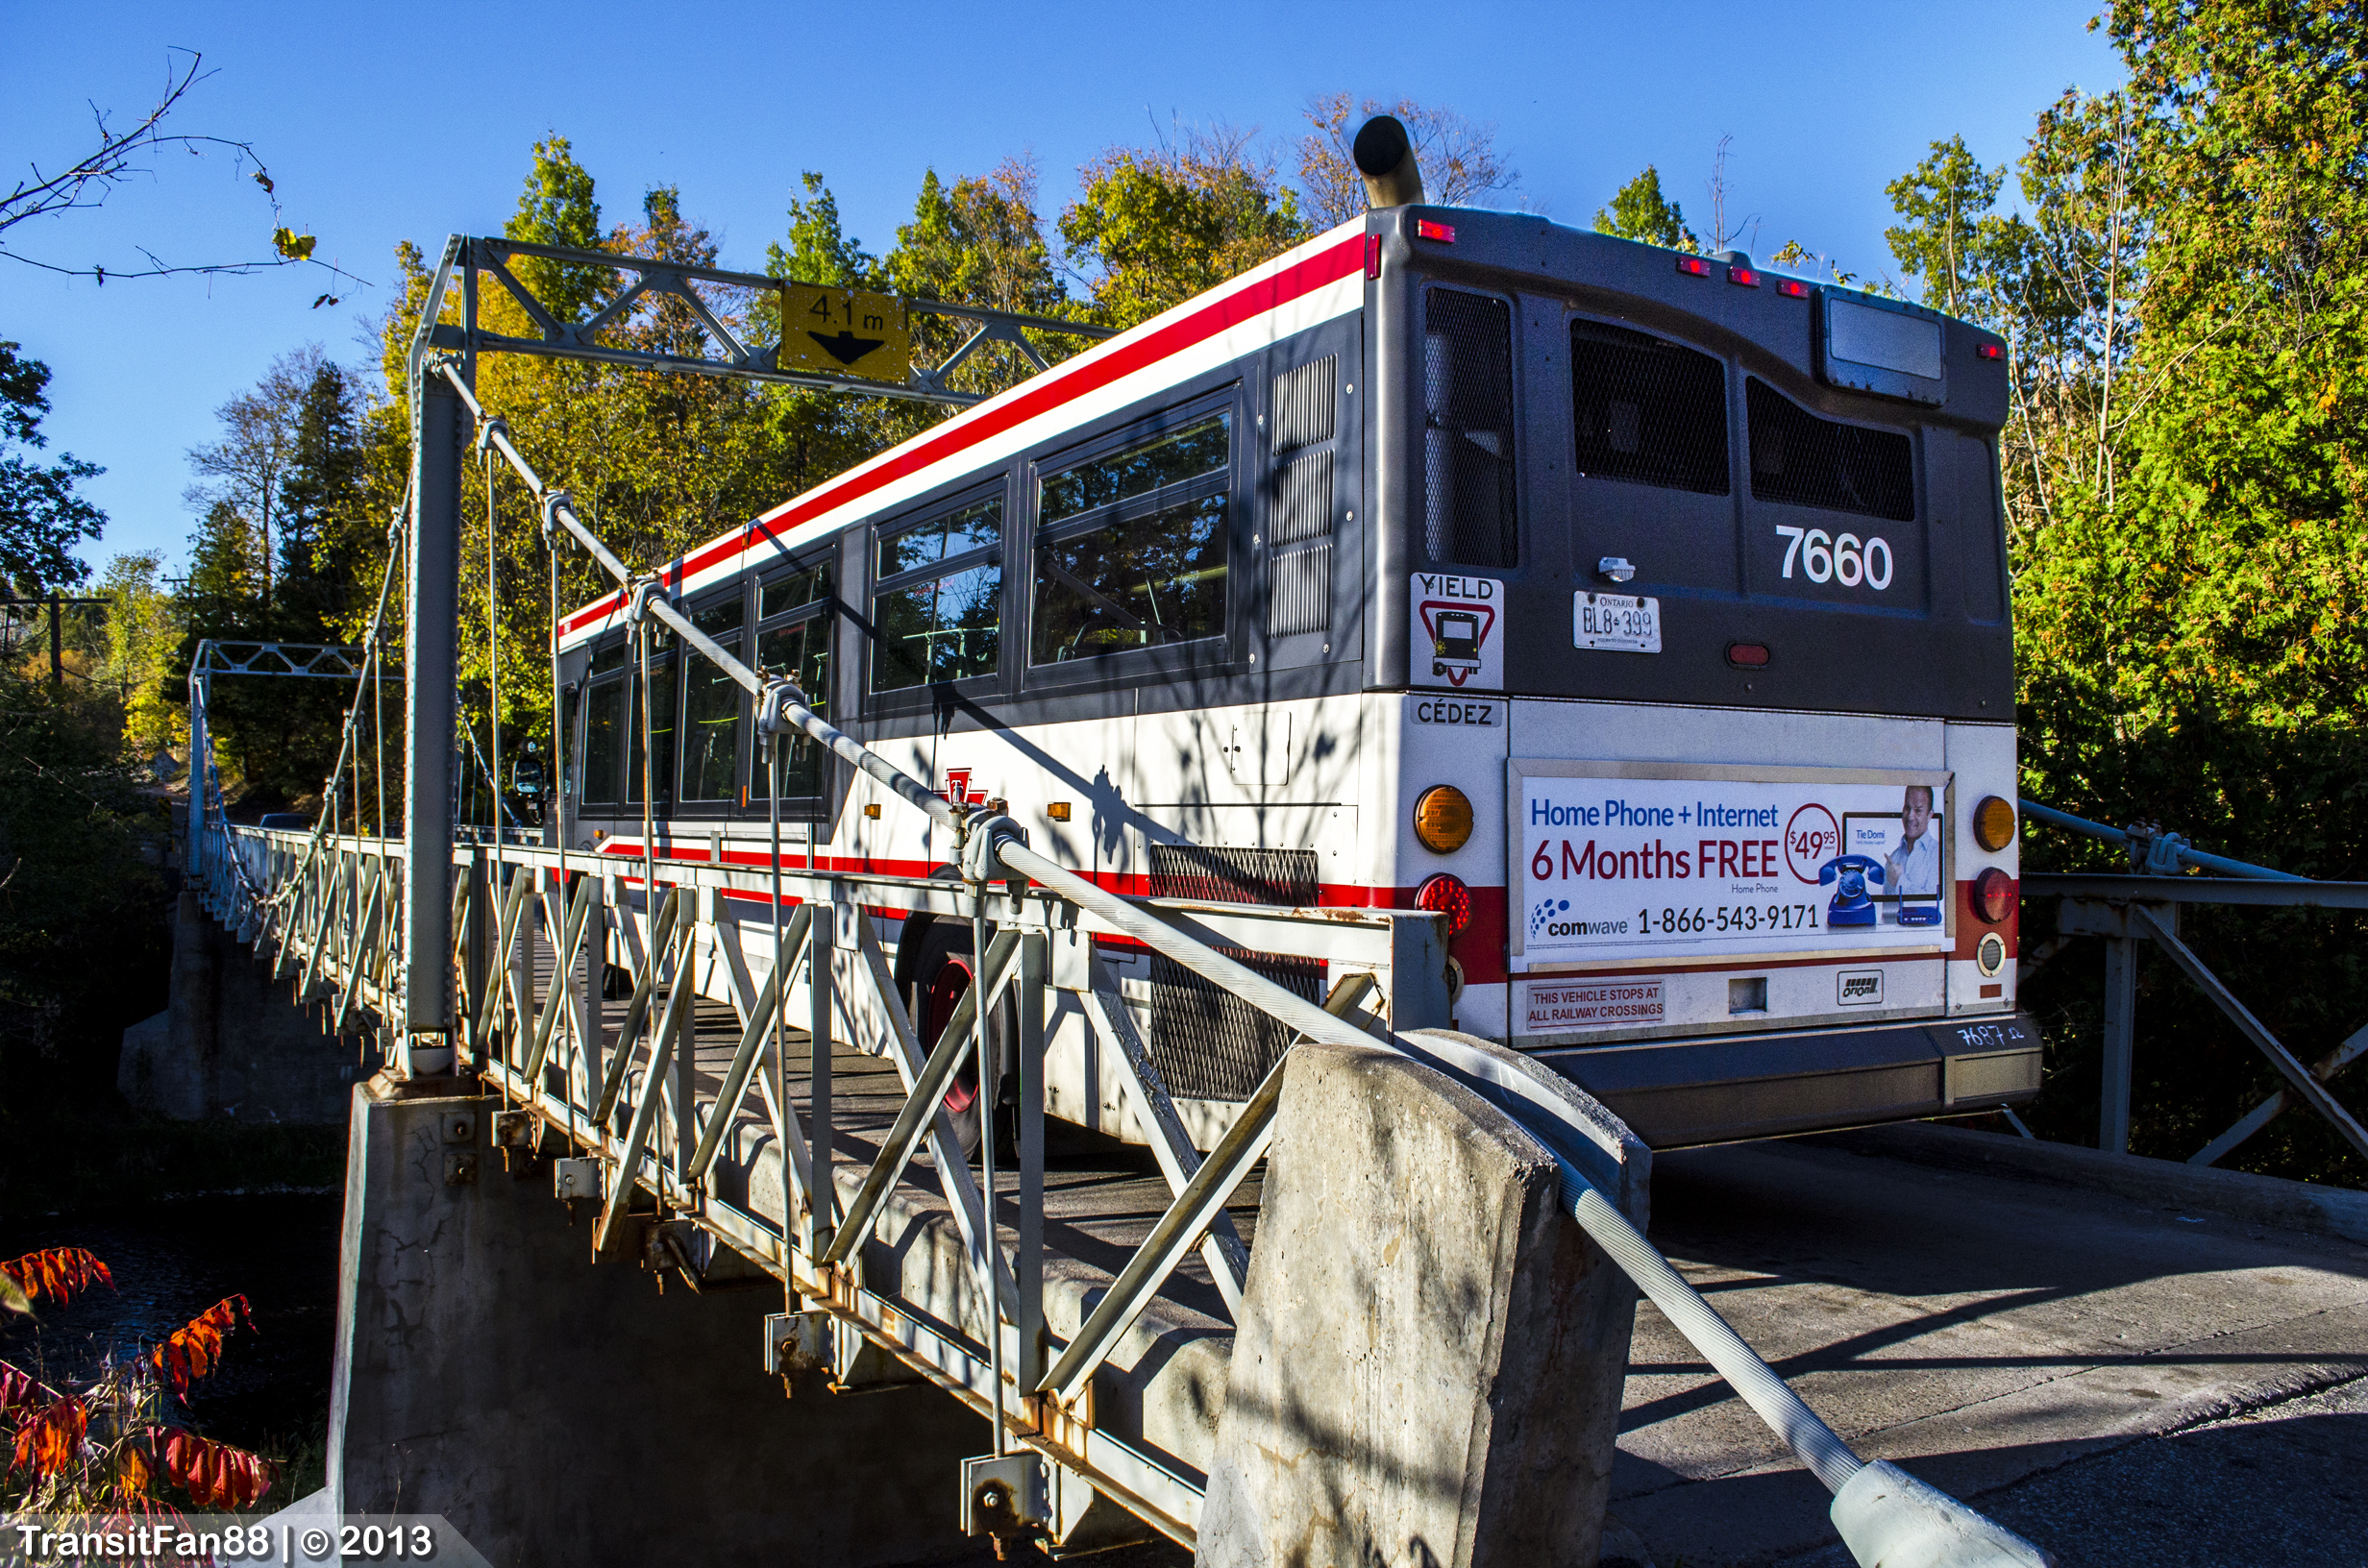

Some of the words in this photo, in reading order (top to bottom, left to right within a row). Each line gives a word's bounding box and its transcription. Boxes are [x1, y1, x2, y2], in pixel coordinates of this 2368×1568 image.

[809, 294, 852, 326] 4.1
[863, 313, 883, 331] m
[1775, 525, 1893, 591] 7660
[1418, 574, 1493, 600] YIELD
[1418, 698, 1492, 725] CÉDEZ
[1531, 798, 1600, 827] Home
[1605, 799, 1674, 827] Phone
[1697, 801, 1779, 828] Internet
[1531, 840, 1554, 881] 6
[1562, 839, 1690, 880] Months
[1698, 840, 1779, 879] FREE
[1731, 883, 1754, 894] Home
[1756, 883, 1779, 894] Phone
[1548, 920, 1628, 937] comwave
[1638, 904, 1819, 935] 1-866-543-9171
[1534, 992, 1559, 1005] THIS
[1561, 990, 1607, 1003] VEHICLE
[1609, 988, 1644, 1001] STOPS
[1645, 988, 1659, 999] AT
[1528, 1010, 1550, 1021] ALL
[1551, 1007, 1598, 1020] RAILWAY
[1599, 1003, 1664, 1017] CROSSINGS
[1957, 1025, 2005, 1046] 7687
